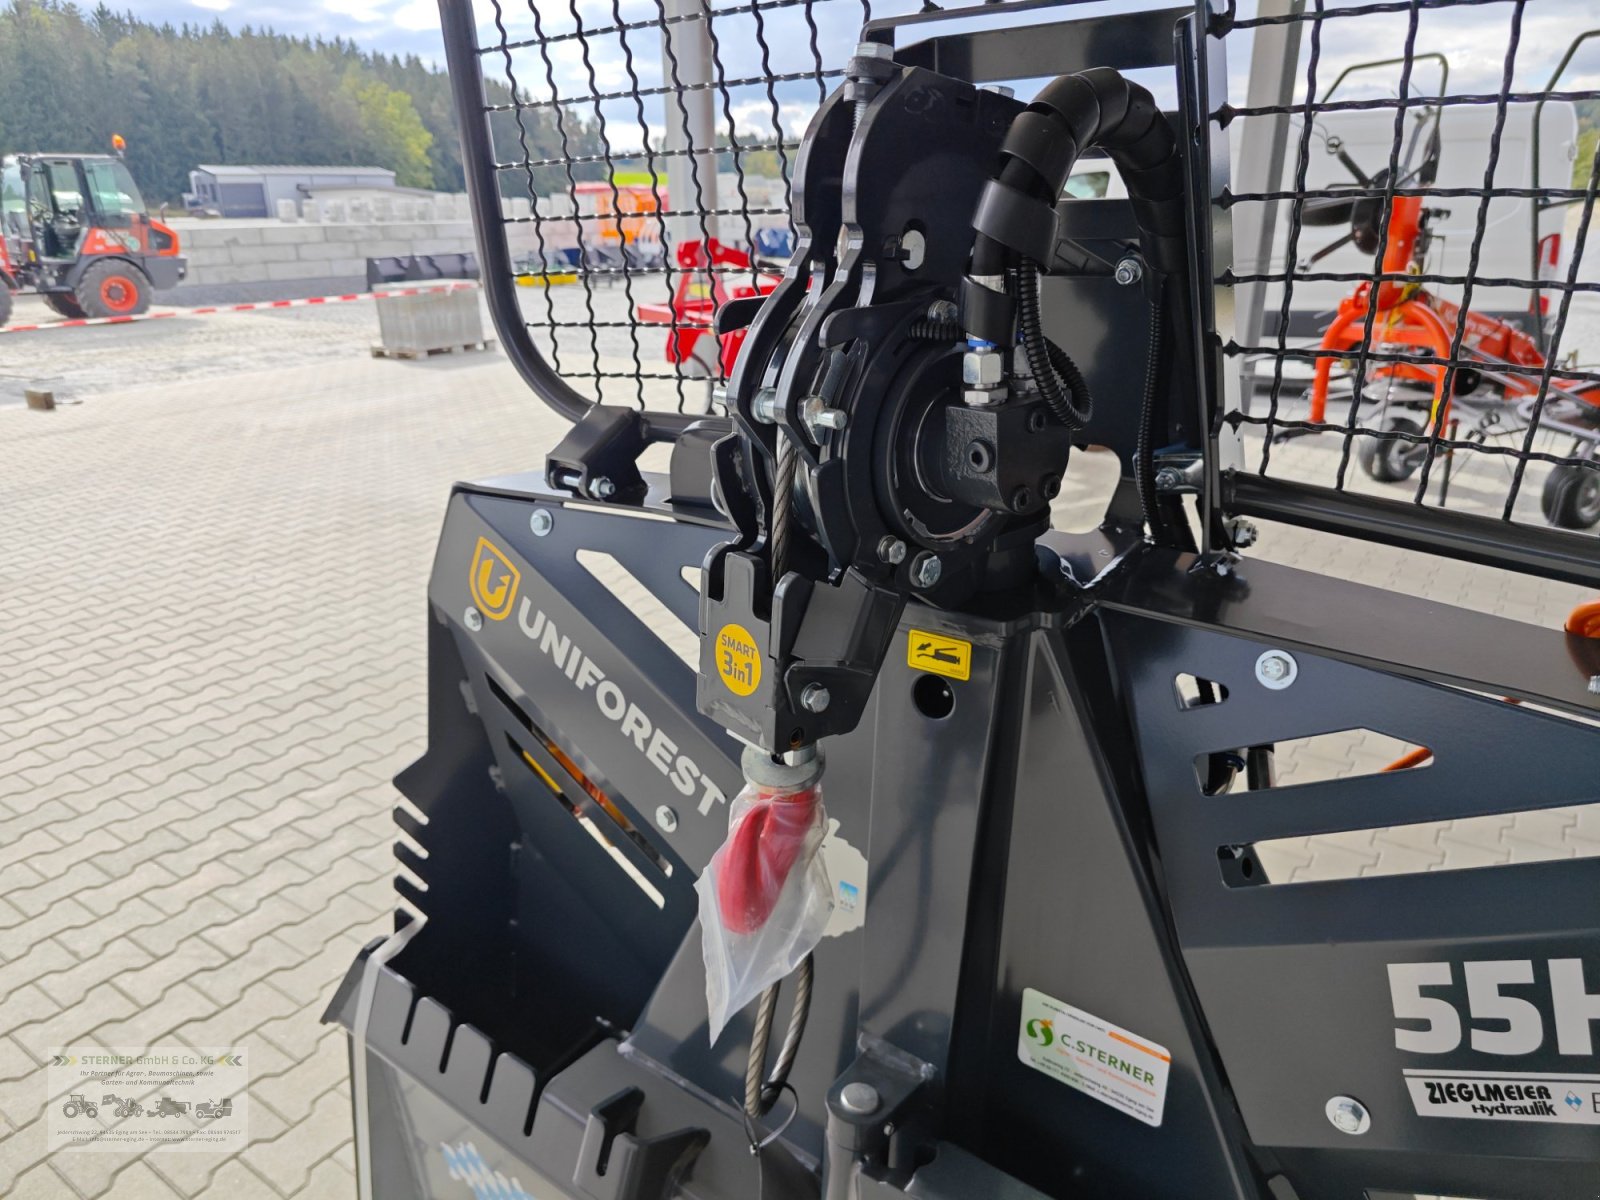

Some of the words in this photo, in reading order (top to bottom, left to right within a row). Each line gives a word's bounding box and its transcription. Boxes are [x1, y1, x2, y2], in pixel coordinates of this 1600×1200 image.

[721, 634, 756, 659] SMART
[518, 596, 726, 816] UNIFOREST
[1061, 1034, 1154, 1086] C.STERNER
[1424, 1082, 1552, 1104] ZIEGLMEIER
[1471, 1102, 1557, 1117] Hydraulik
